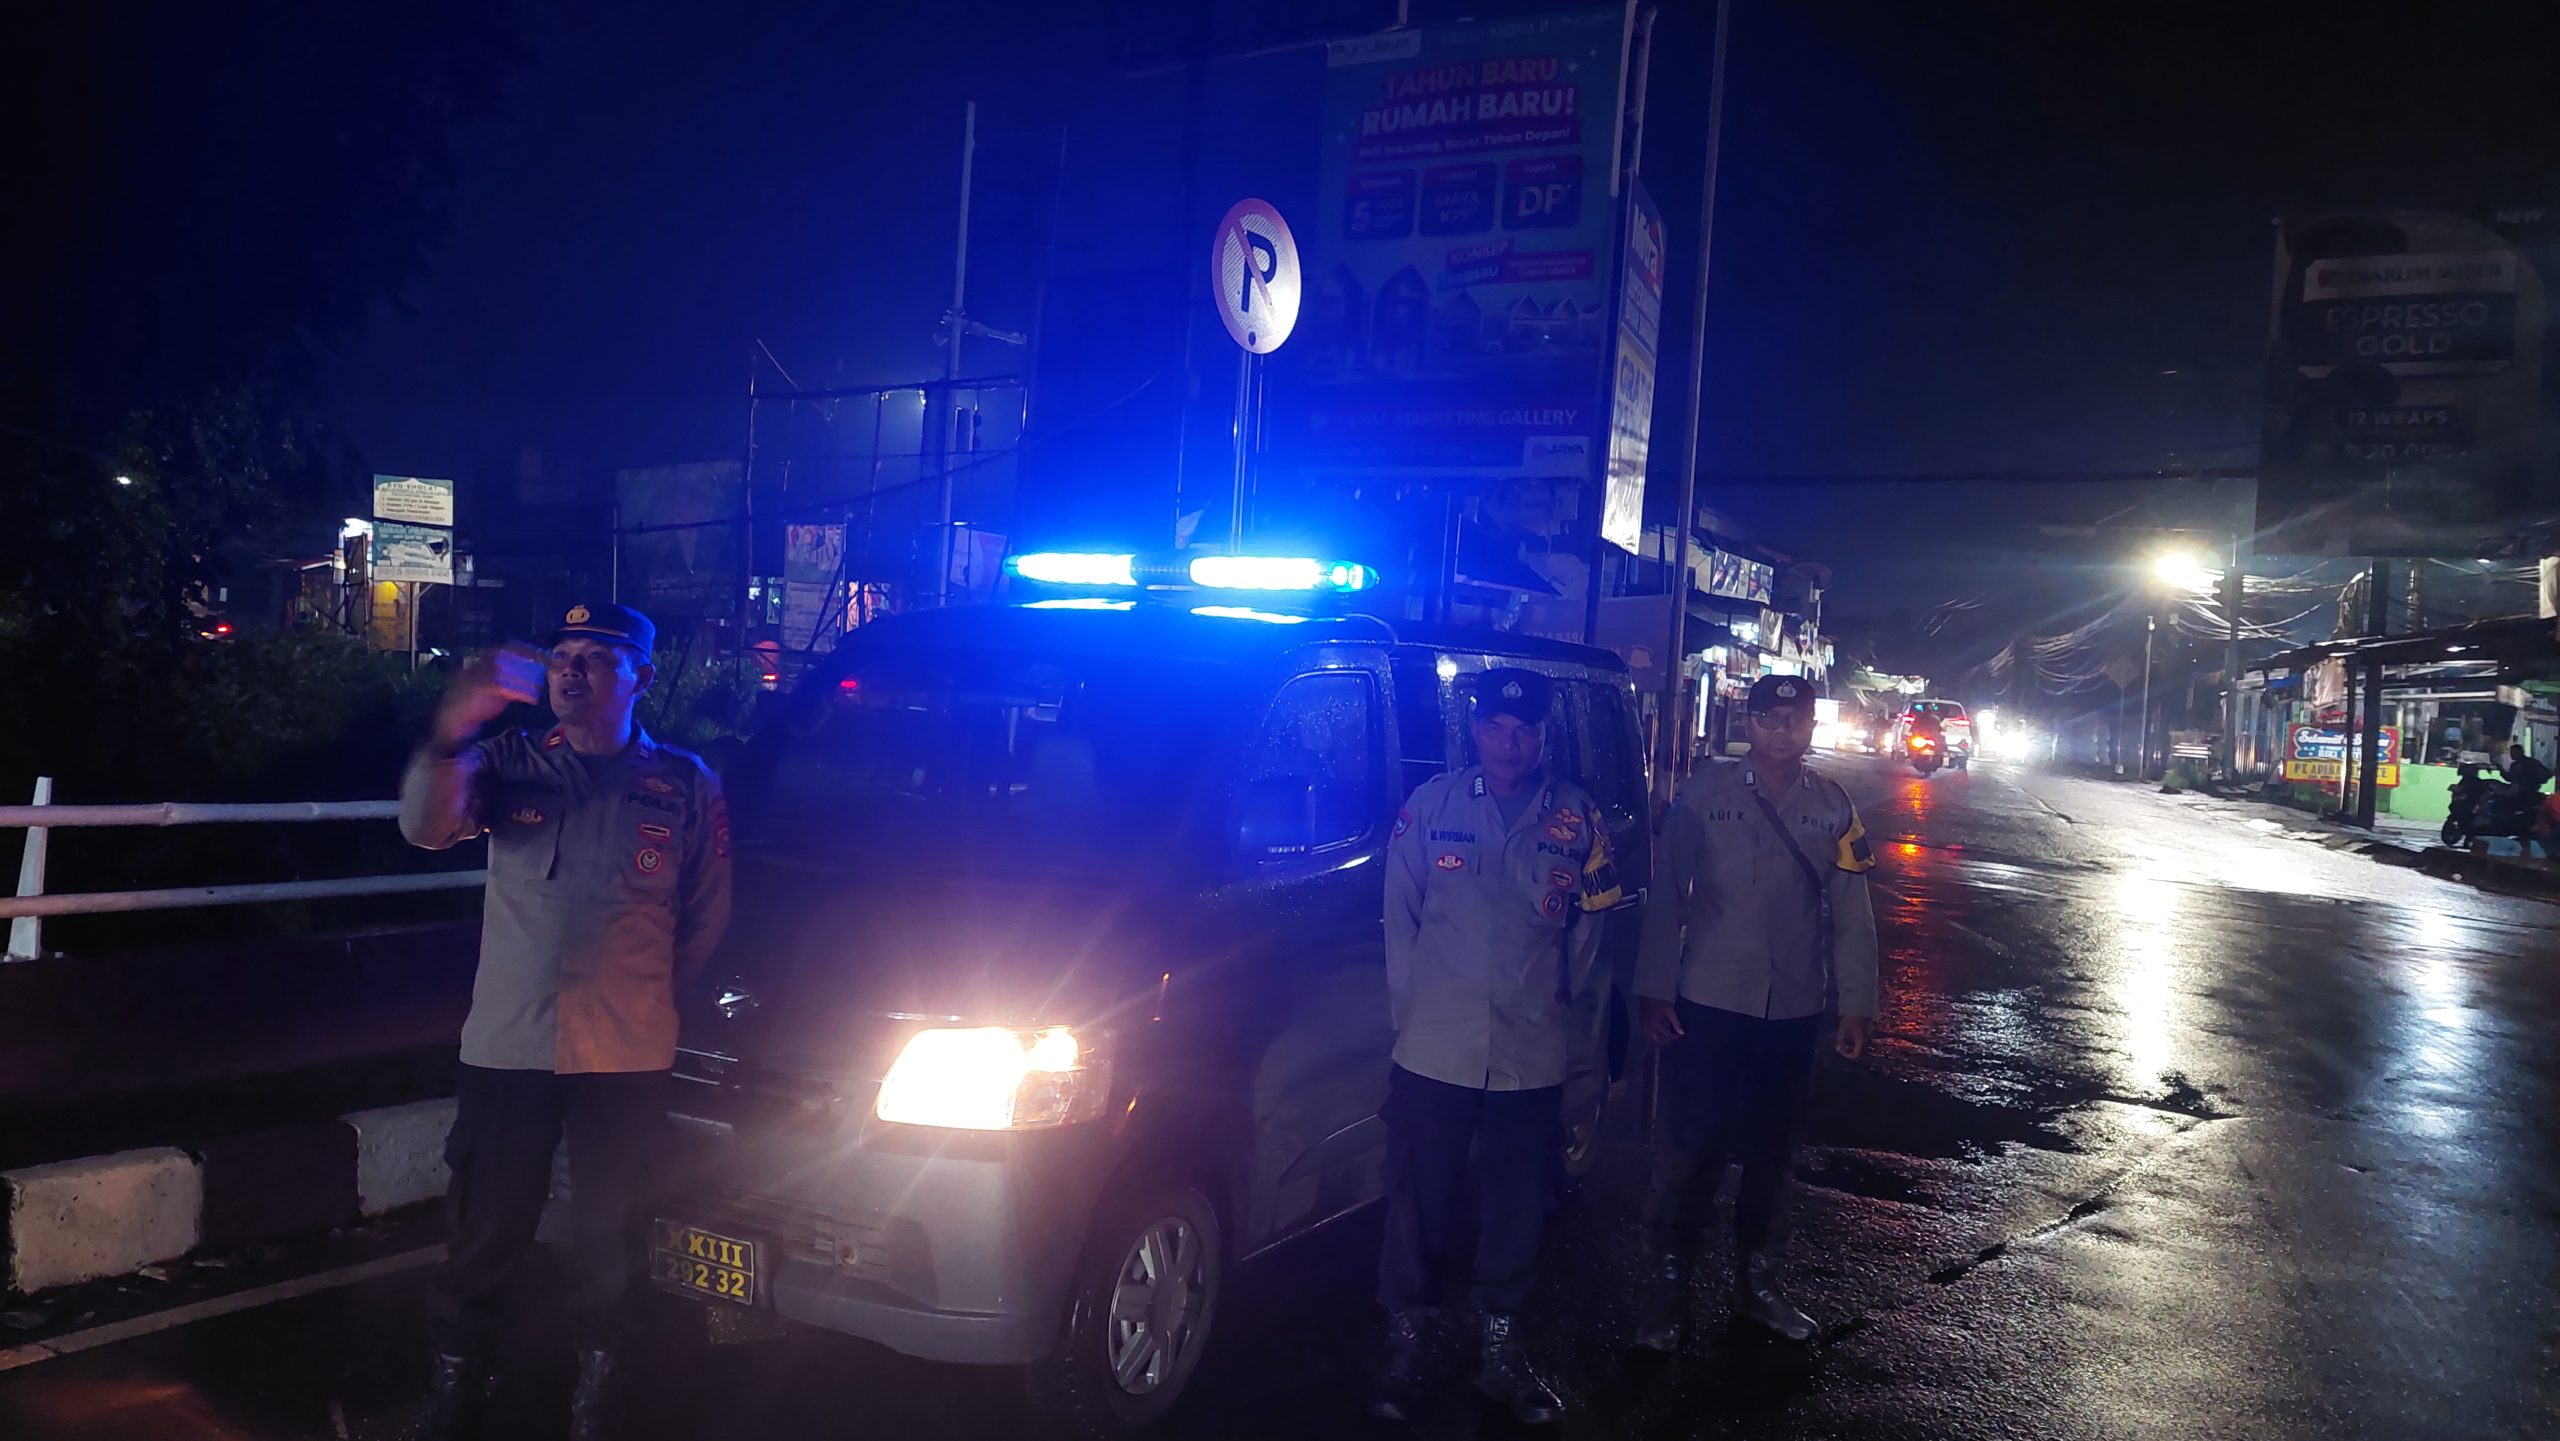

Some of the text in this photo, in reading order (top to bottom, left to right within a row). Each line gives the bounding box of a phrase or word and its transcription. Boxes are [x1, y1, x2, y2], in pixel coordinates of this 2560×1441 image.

[1383, 56, 1560, 99] TAHUN BARU
[1361, 87, 1576, 137] RUMAH BARU!
[1483, 132, 1522, 146] Tahun
[1350, 199, 1372, 232] 5
[1241, 229, 1277, 313] P
[2325, 301, 2488, 332] ESPRESSO
[2355, 333, 2451, 356] GOLD
[1393, 409, 1495, 427] MARKETING
[1497, 408, 1578, 427] GALLERY
[1546, 443, 1585, 455] JAYA
